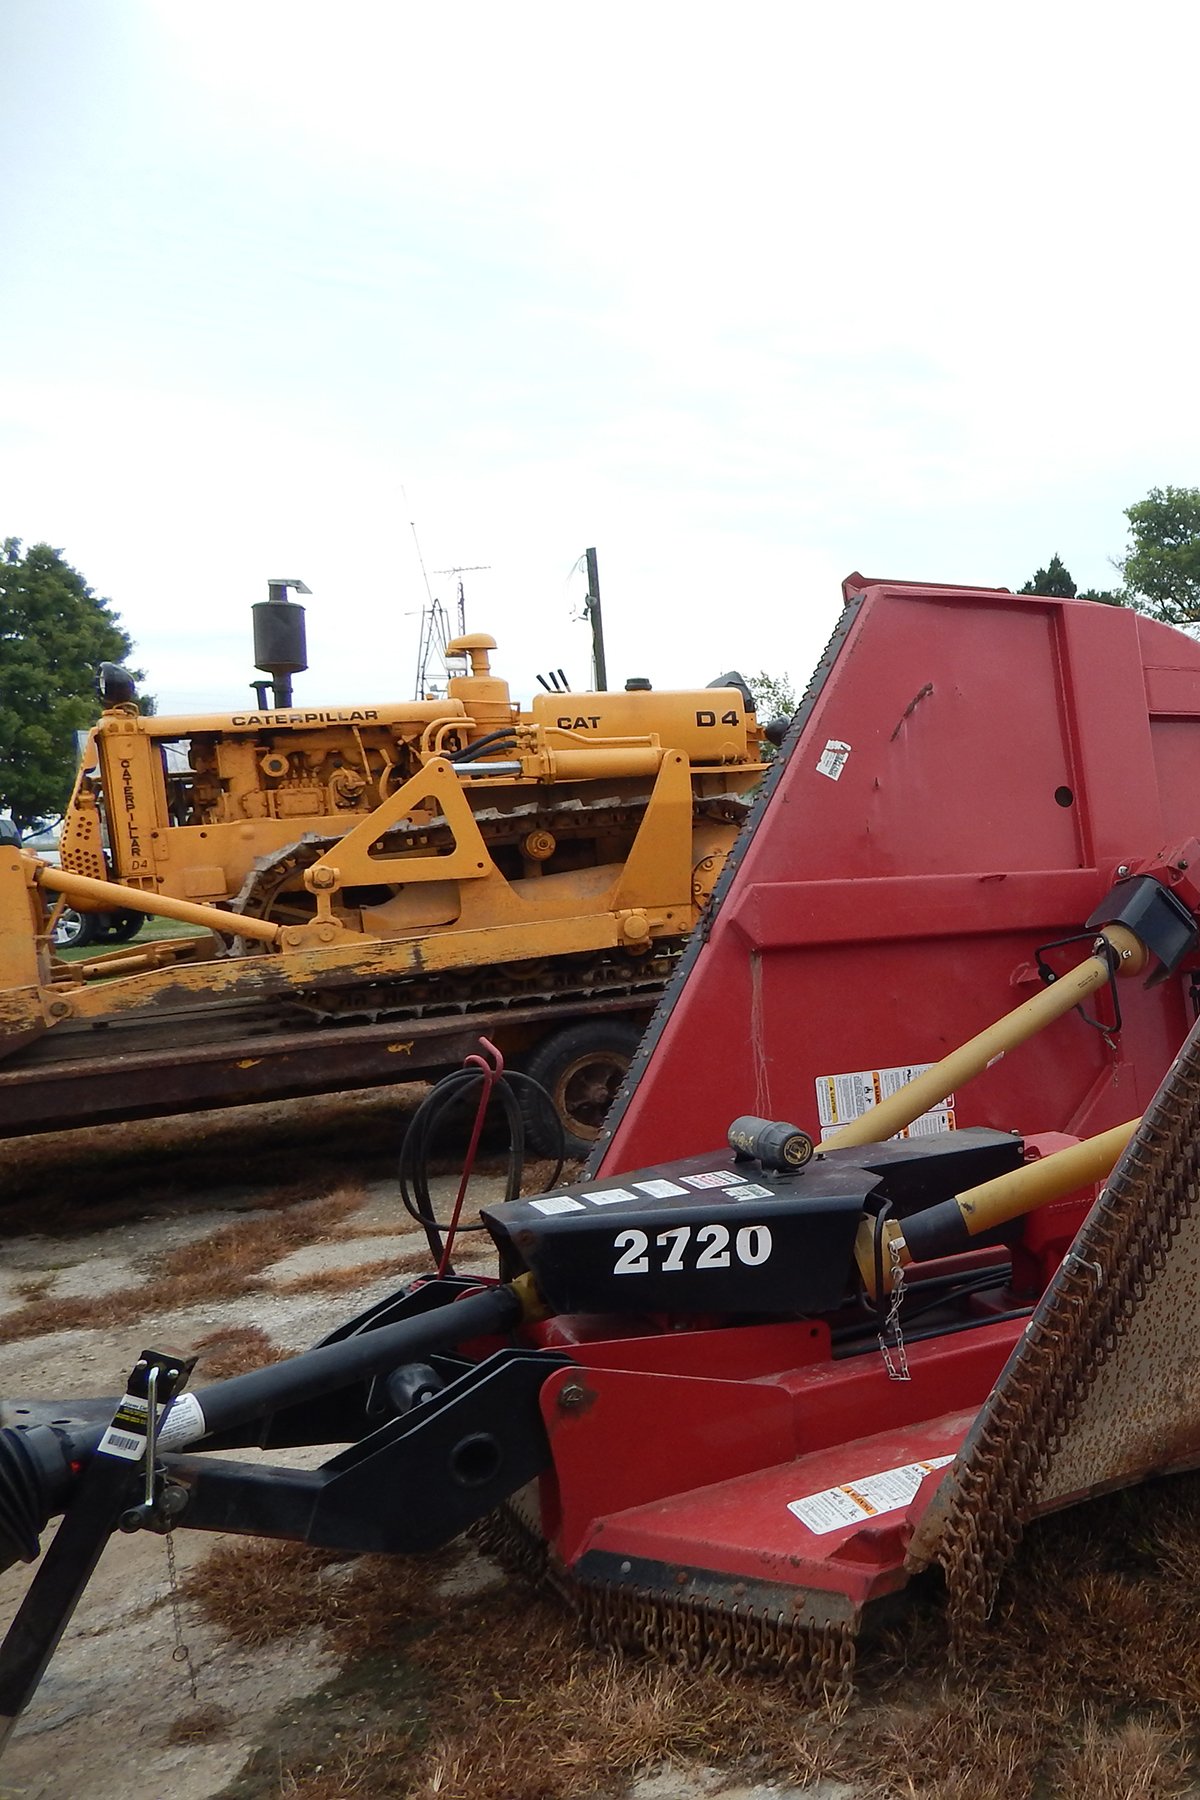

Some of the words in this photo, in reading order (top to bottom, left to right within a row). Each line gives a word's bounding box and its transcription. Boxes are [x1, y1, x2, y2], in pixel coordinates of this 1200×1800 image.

[232, 710, 378, 726] CATERPILLAR
[557, 716, 601, 730] CAT
[121, 760, 141, 857] CATERPILLAR
[132, 860, 148, 870] D4
[613, 1224, 773, 1275] 2720
